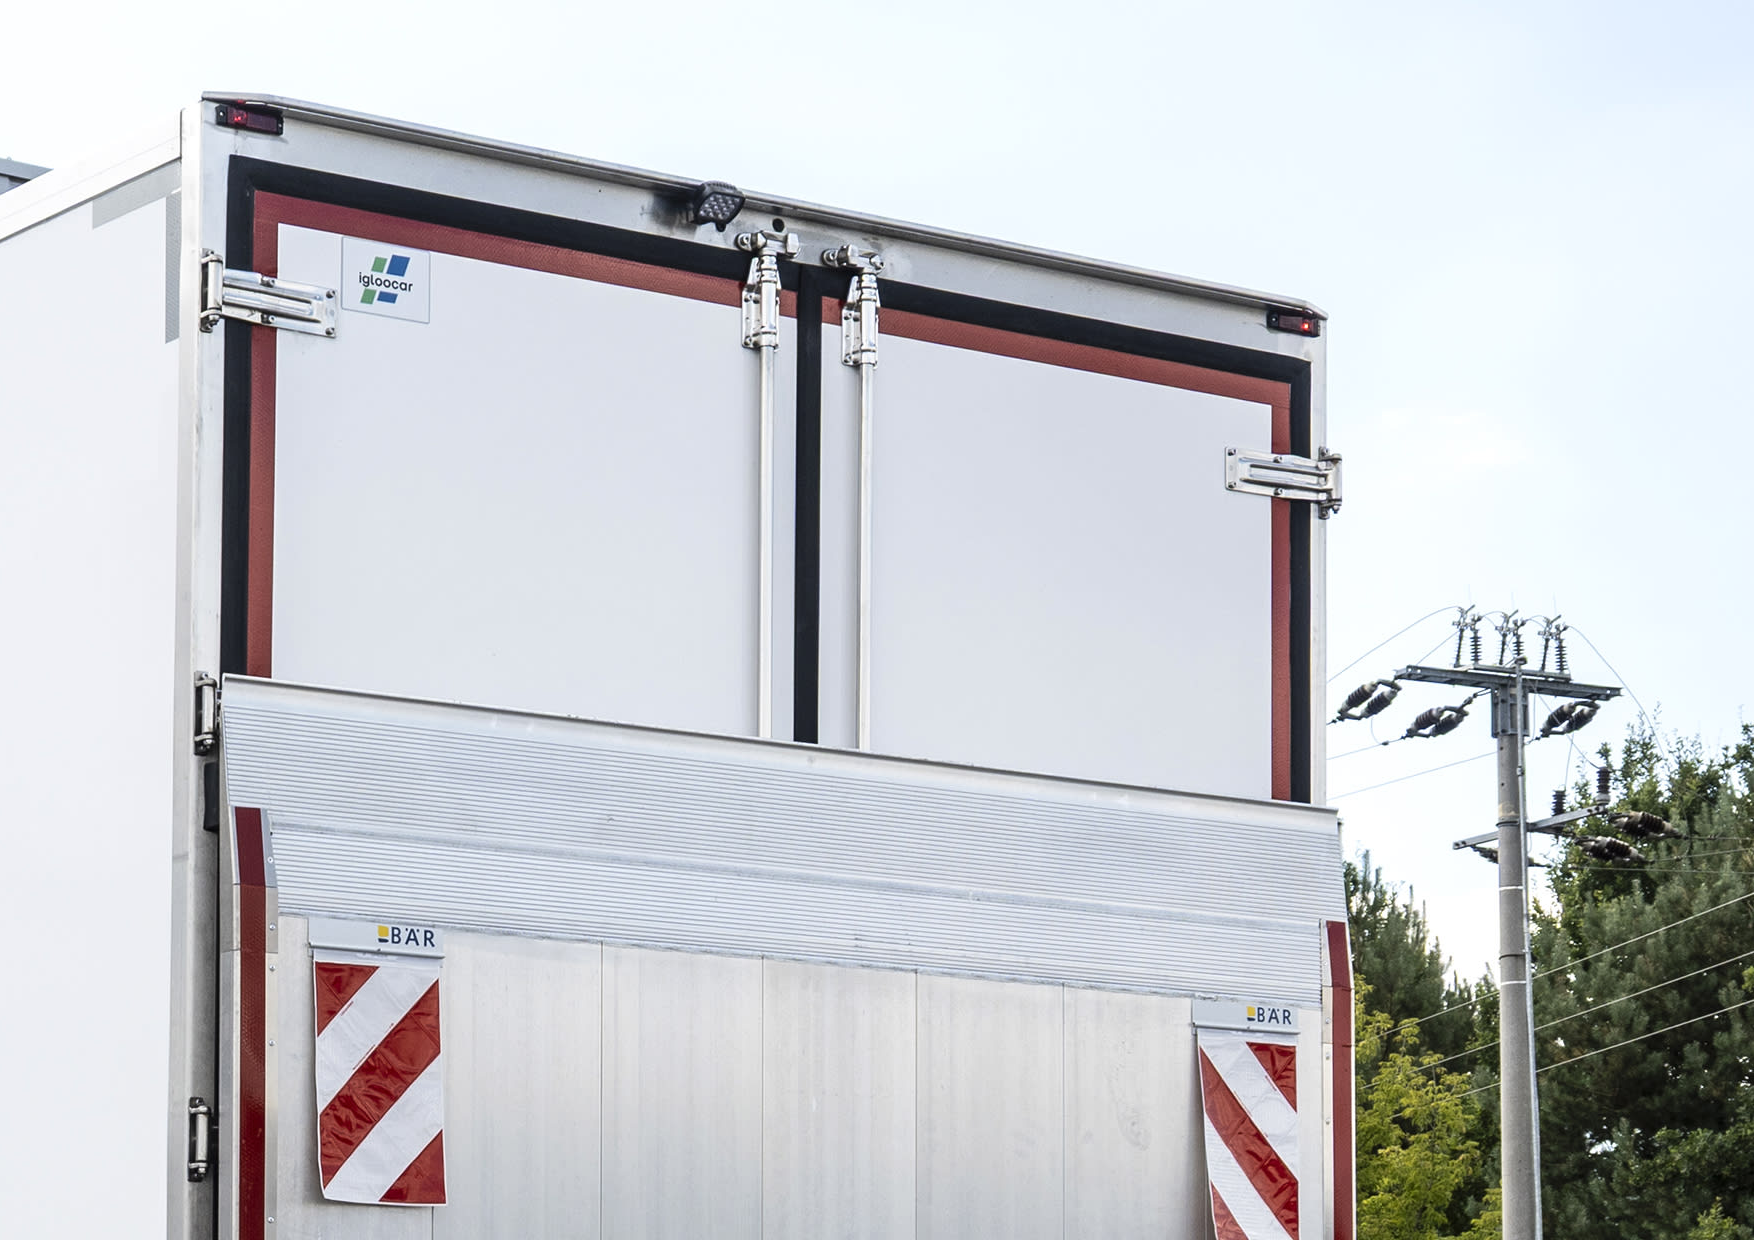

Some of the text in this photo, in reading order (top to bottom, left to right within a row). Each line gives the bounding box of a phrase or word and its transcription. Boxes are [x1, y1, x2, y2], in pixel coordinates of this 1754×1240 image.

[358, 271, 414, 292] igloocar
[390, 926, 436, 948] BÄR
[1257, 1006, 1292, 1025] BÄR
